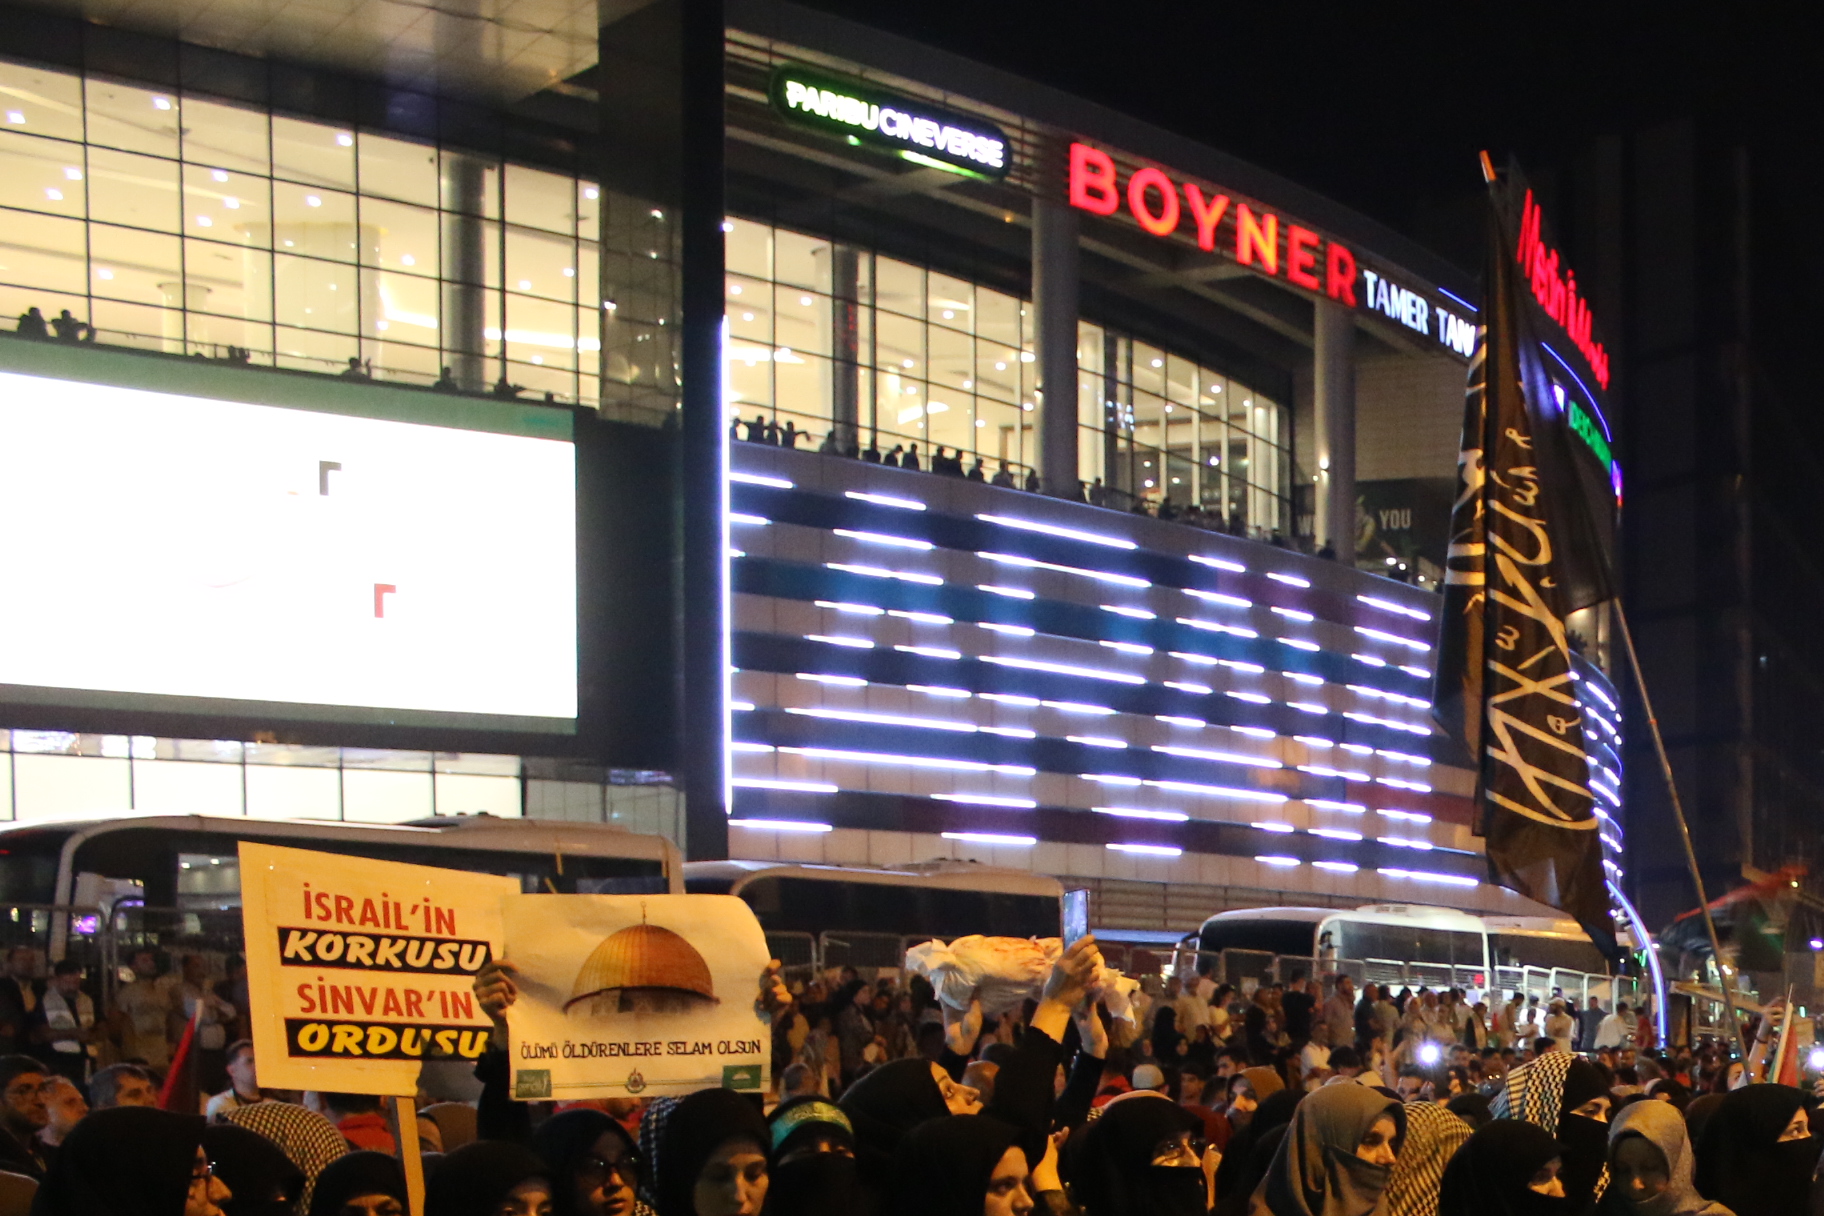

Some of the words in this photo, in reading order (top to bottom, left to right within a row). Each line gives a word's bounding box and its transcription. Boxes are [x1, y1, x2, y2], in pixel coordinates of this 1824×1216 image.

[1068, 141, 1357, 308] BOYNER
[1363, 269, 1430, 335] TAMER
[1379, 508, 1412, 530] YOU
[302, 882, 456, 936] İSRAİL'İN
[283, 930, 487, 971] KORKUSU
[297, 976, 474, 1019] SİNVAR'IN
[297, 1023, 489, 1058] ORDUSU
[521, 1041, 559, 1060] ÖLÜMÜ
[563, 1039, 663, 1058] ÖLDÜRENLERE
[667, 1040, 713, 1056] SELAM
[717, 1039, 762, 1055] OLSUN
